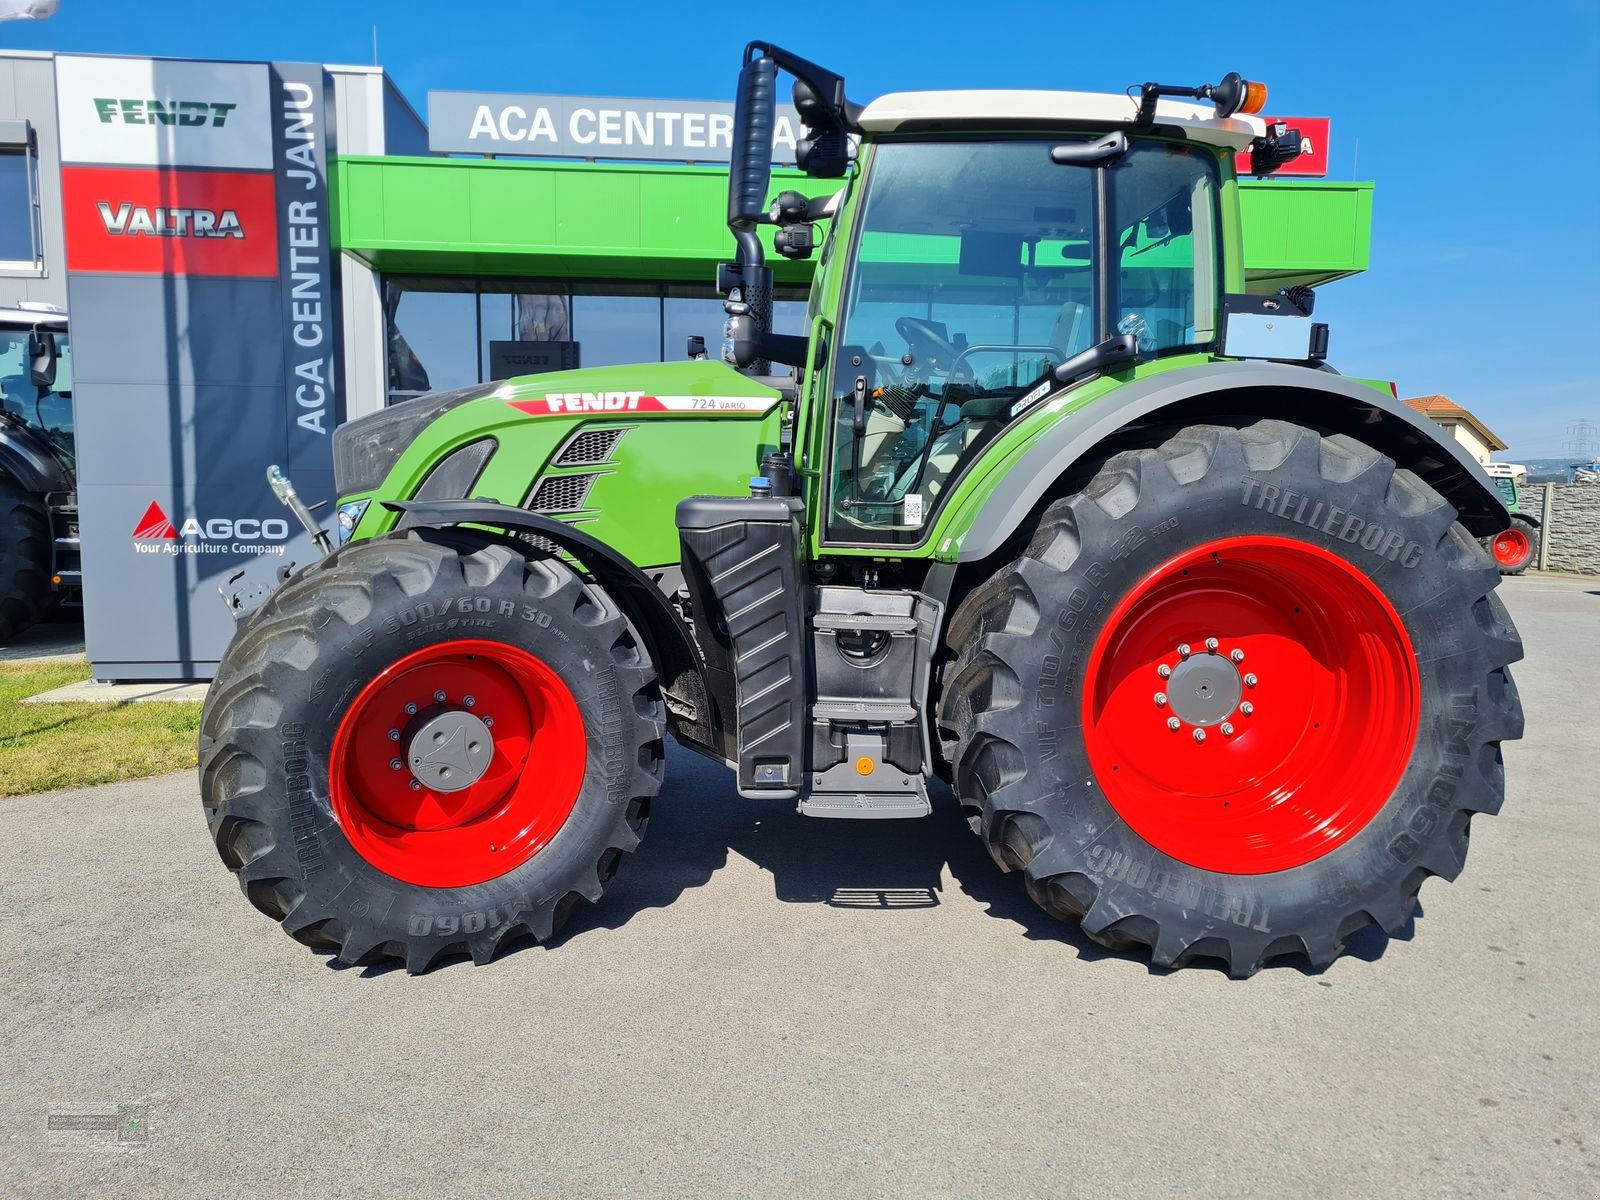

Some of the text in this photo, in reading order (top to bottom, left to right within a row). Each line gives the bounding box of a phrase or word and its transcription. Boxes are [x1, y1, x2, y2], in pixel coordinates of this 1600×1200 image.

[94, 98, 237, 127] FENDT
[468, 105, 558, 142] ACA
[568, 108, 734, 149] CENTER
[97, 201, 246, 239] VALTRA
[282, 82, 326, 434] ACA CENTER JANU
[545, 391, 747, 412] FENDT 724 VARIO
[134, 542, 286, 556] Your Agriculture Company
[180, 518, 288, 539] AGCO
[1240, 475, 1425, 569] TRELLEBORG
[500, 600, 515, 618] R
[522, 604, 554, 629] 30
[1035, 587, 1090, 711] 710/60
[1082, 562, 1109, 587] R
[1110, 525, 1148, 563] 42
[595, 663, 627, 806] TRELLEBORG
[280, 722, 326, 881] TRELLEBORG
[1387, 684, 1480, 864] TM1060
[1085, 845, 1272, 934] TRELLEBORG
